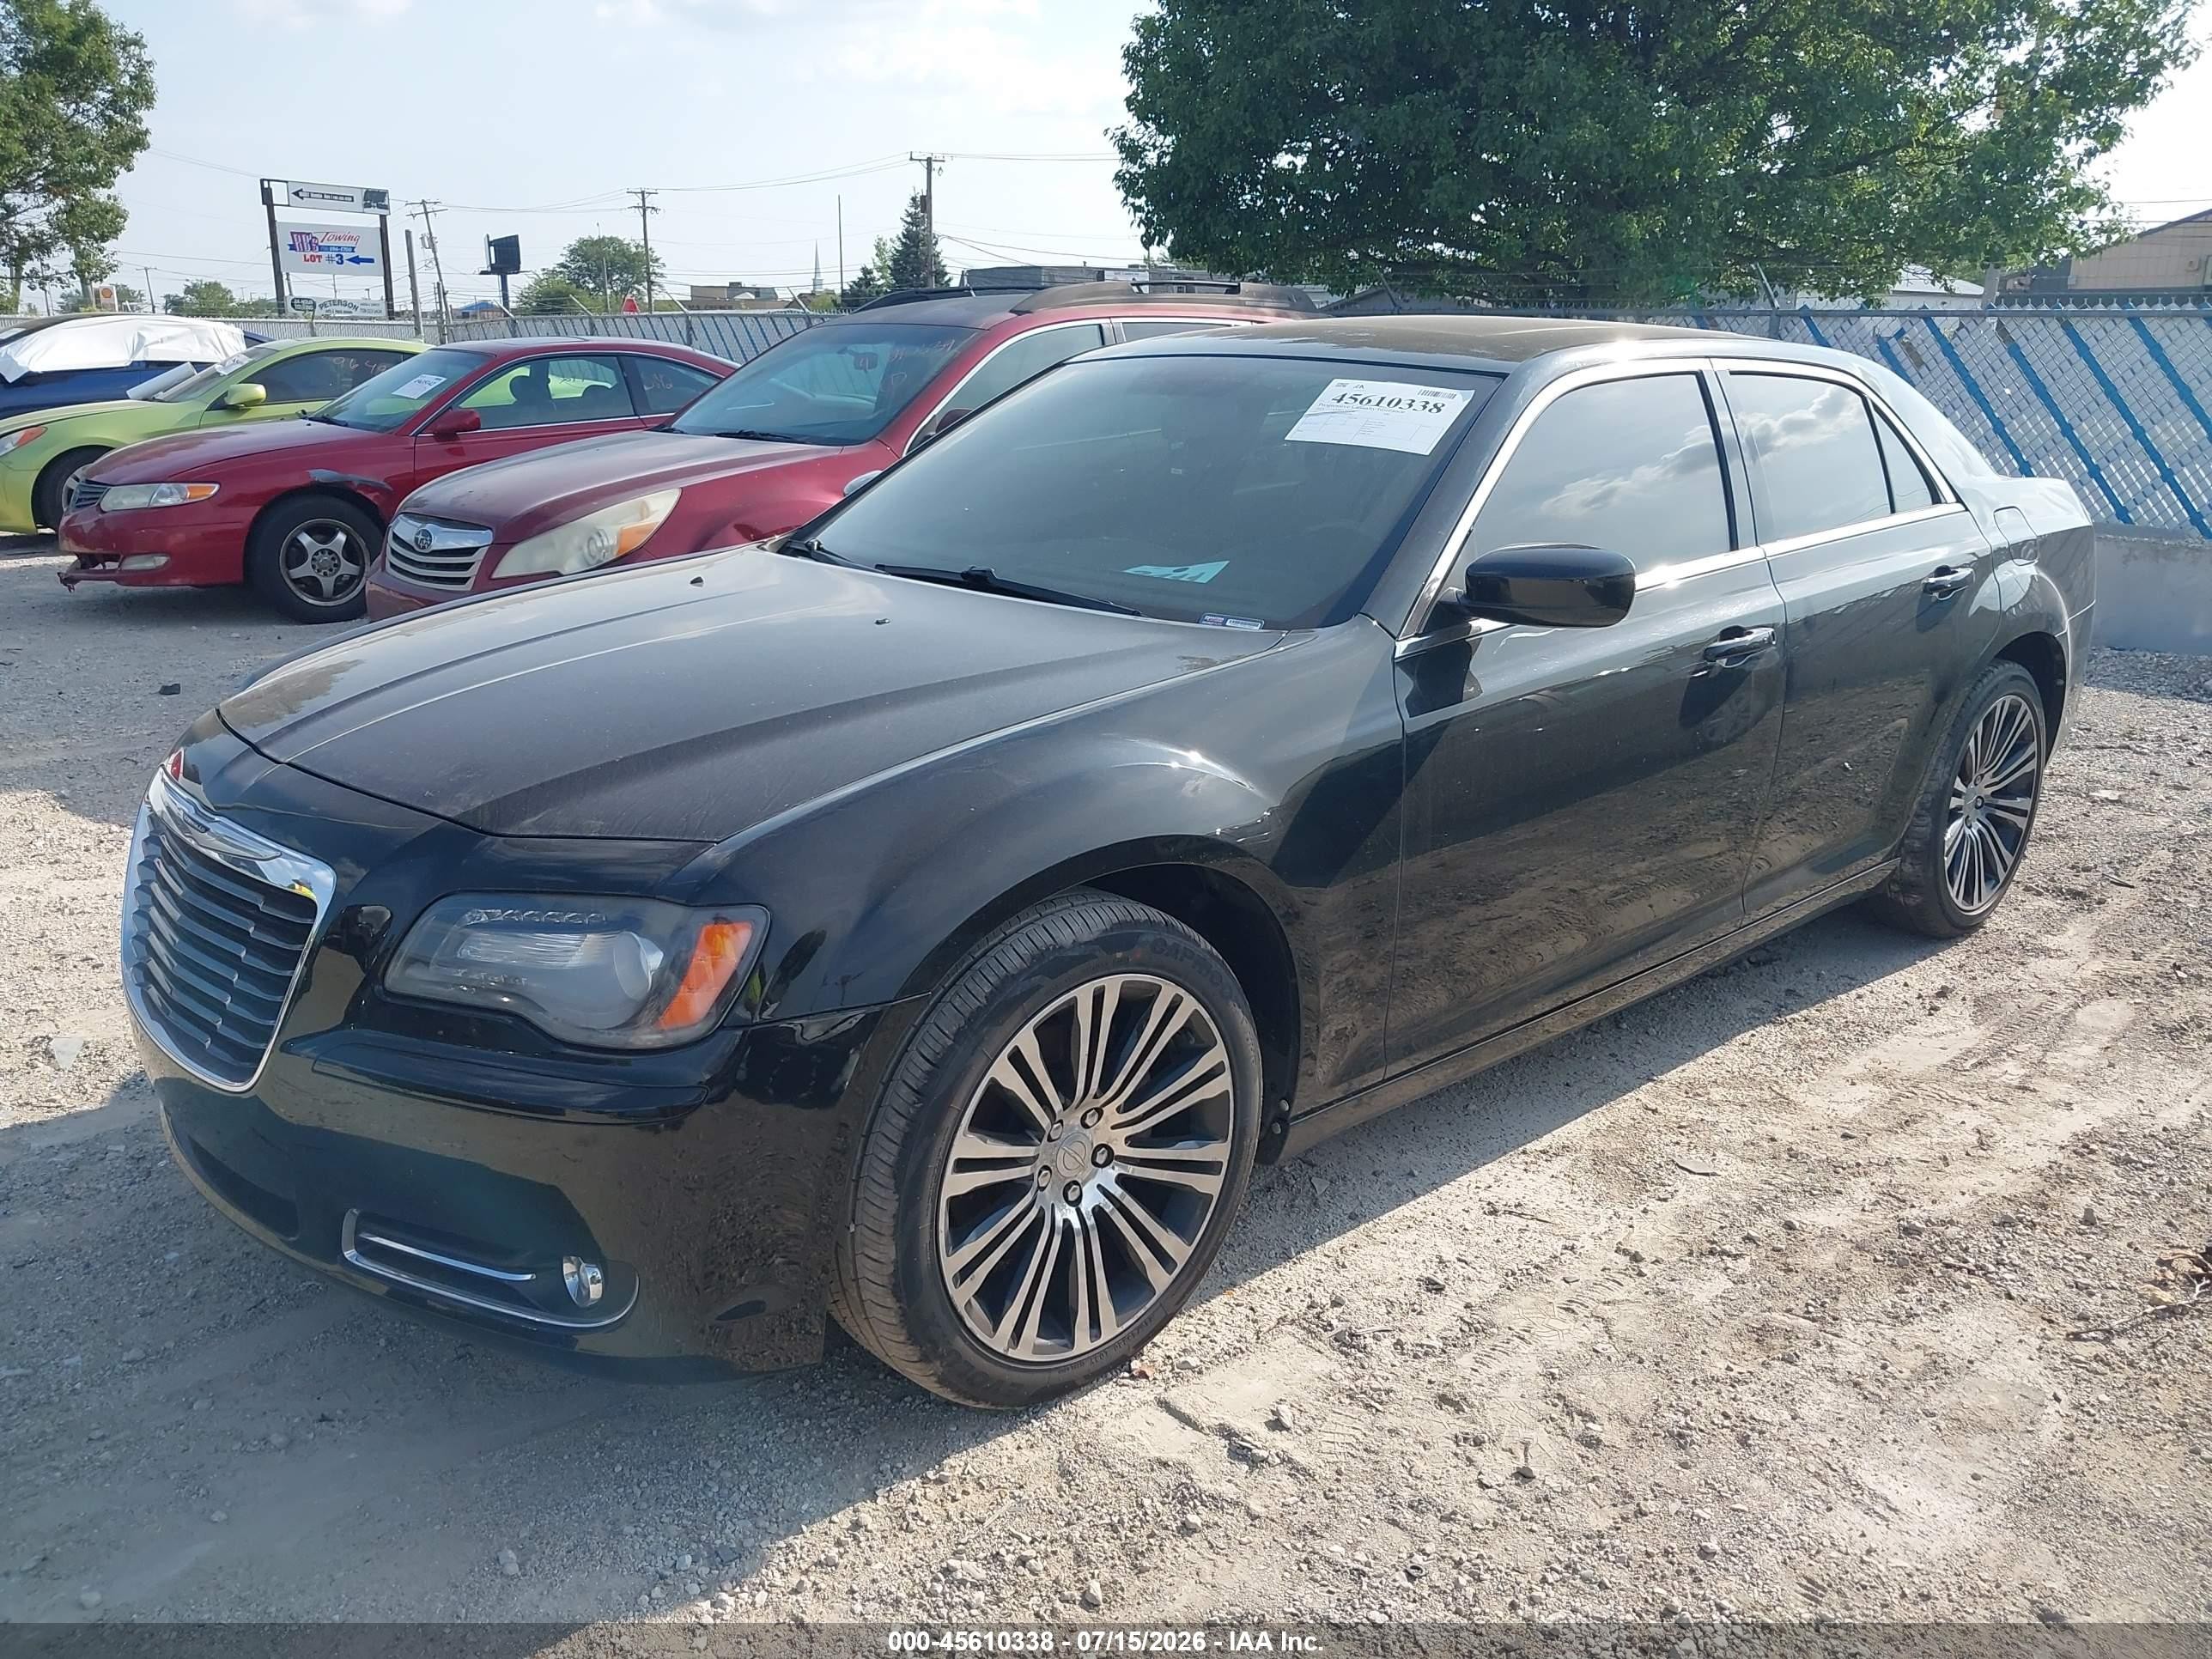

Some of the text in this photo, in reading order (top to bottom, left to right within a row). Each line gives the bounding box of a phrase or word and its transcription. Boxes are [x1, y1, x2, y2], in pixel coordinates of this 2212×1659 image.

[314, 230, 360, 246] Towing
[303, 253, 344, 265] LOT #3
[318, 299, 359, 312] PETERSON
[1332, 392, 1446, 414] 45610338
